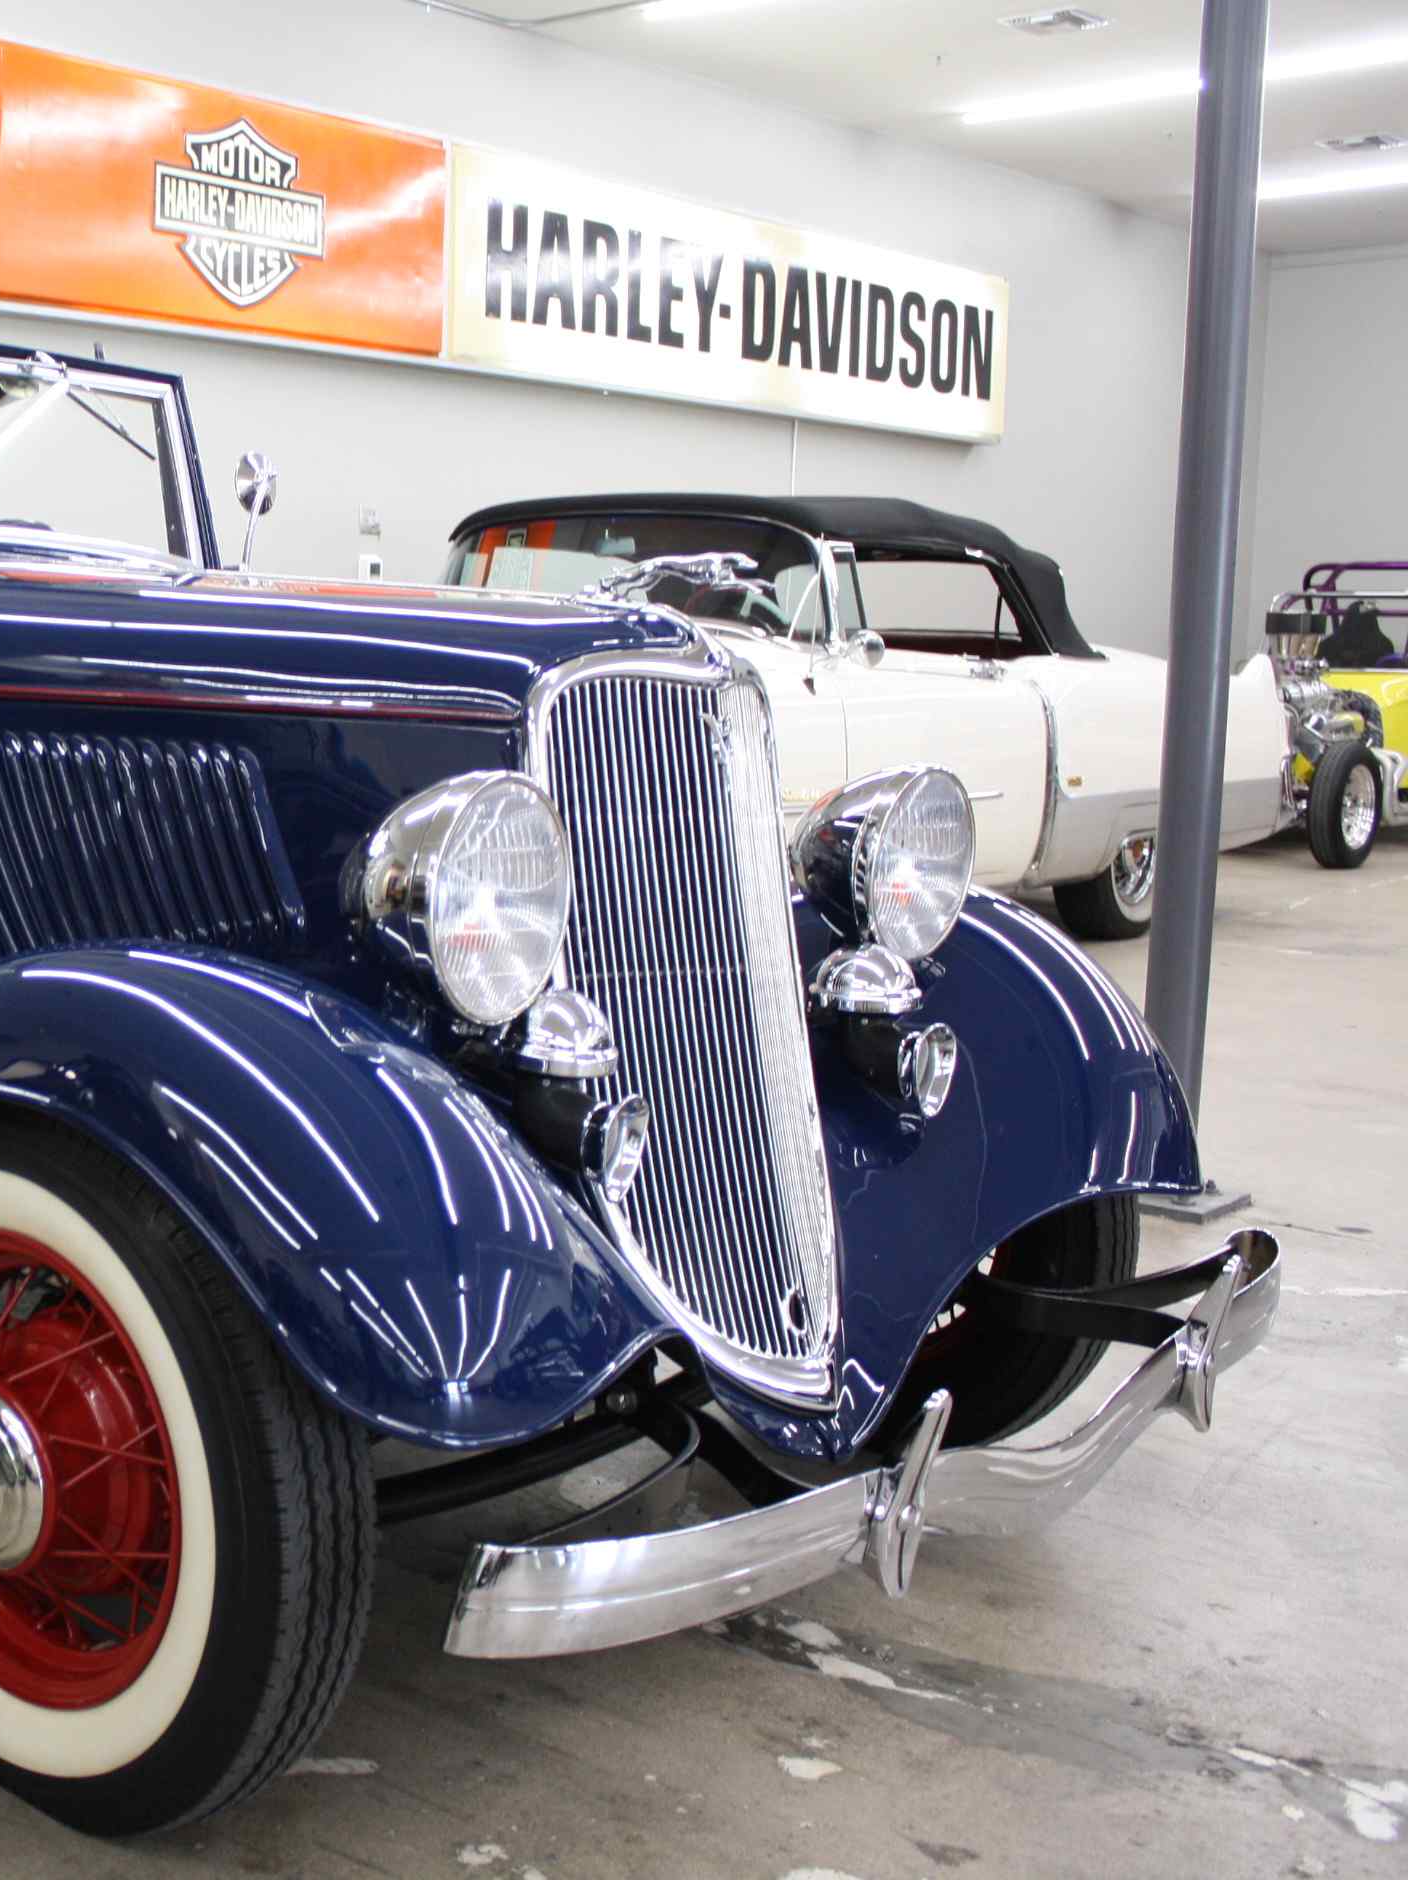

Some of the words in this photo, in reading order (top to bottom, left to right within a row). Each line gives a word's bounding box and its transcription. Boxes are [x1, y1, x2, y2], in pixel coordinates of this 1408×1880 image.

[201, 134, 282, 188] MOTOR
[163, 175, 318, 248] HARLEY-DAVIDSON
[199, 235, 282, 295] CYCLES
[484, 197, 994, 401] HARLEY-DAVIDSON
